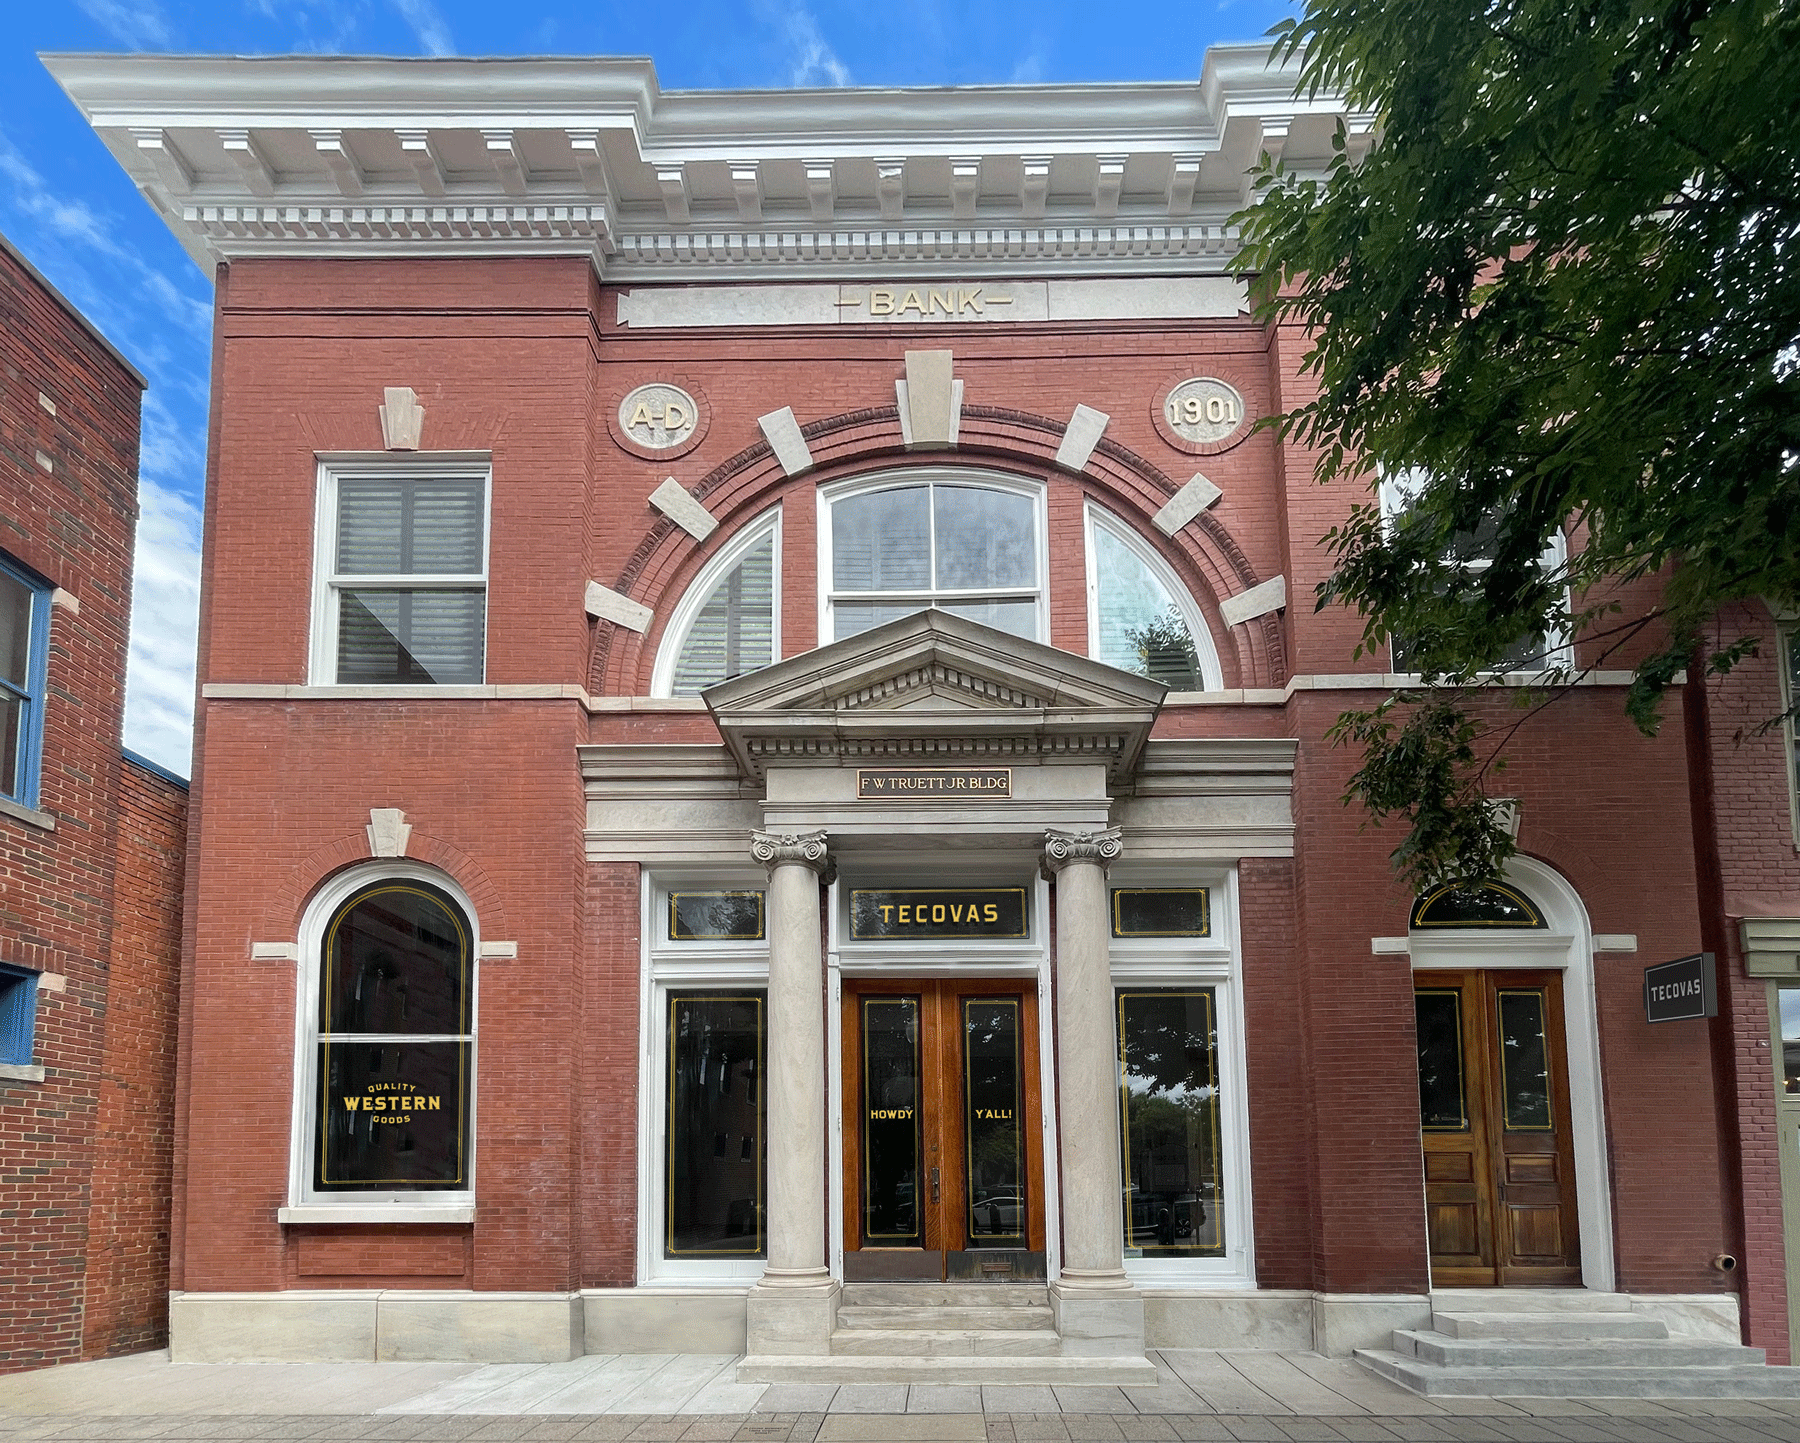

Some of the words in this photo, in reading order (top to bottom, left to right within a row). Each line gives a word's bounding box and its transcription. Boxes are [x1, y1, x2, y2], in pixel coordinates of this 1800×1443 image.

[869, 288, 983, 316] BANK
[1170, 397, 1237, 425] 1901
[861, 778, 870, 789] F
[873, 778, 886, 789] W
[888, 777, 946, 789] TRUETT
[946, 777, 967, 789] JR
[969, 777, 1007, 789] BLDG
[879, 904, 998, 923] TECOVAS
[1650, 978, 1701, 1002] TECOVAS
[367, 1082, 416, 1093] QUALITY
[343, 1096, 441, 1111] WESTERN
[372, 1115, 411, 1124] GOODS
[870, 1110, 914, 1119] HOWDY
[975, 1109, 1012, 1119] Y'ALL!
